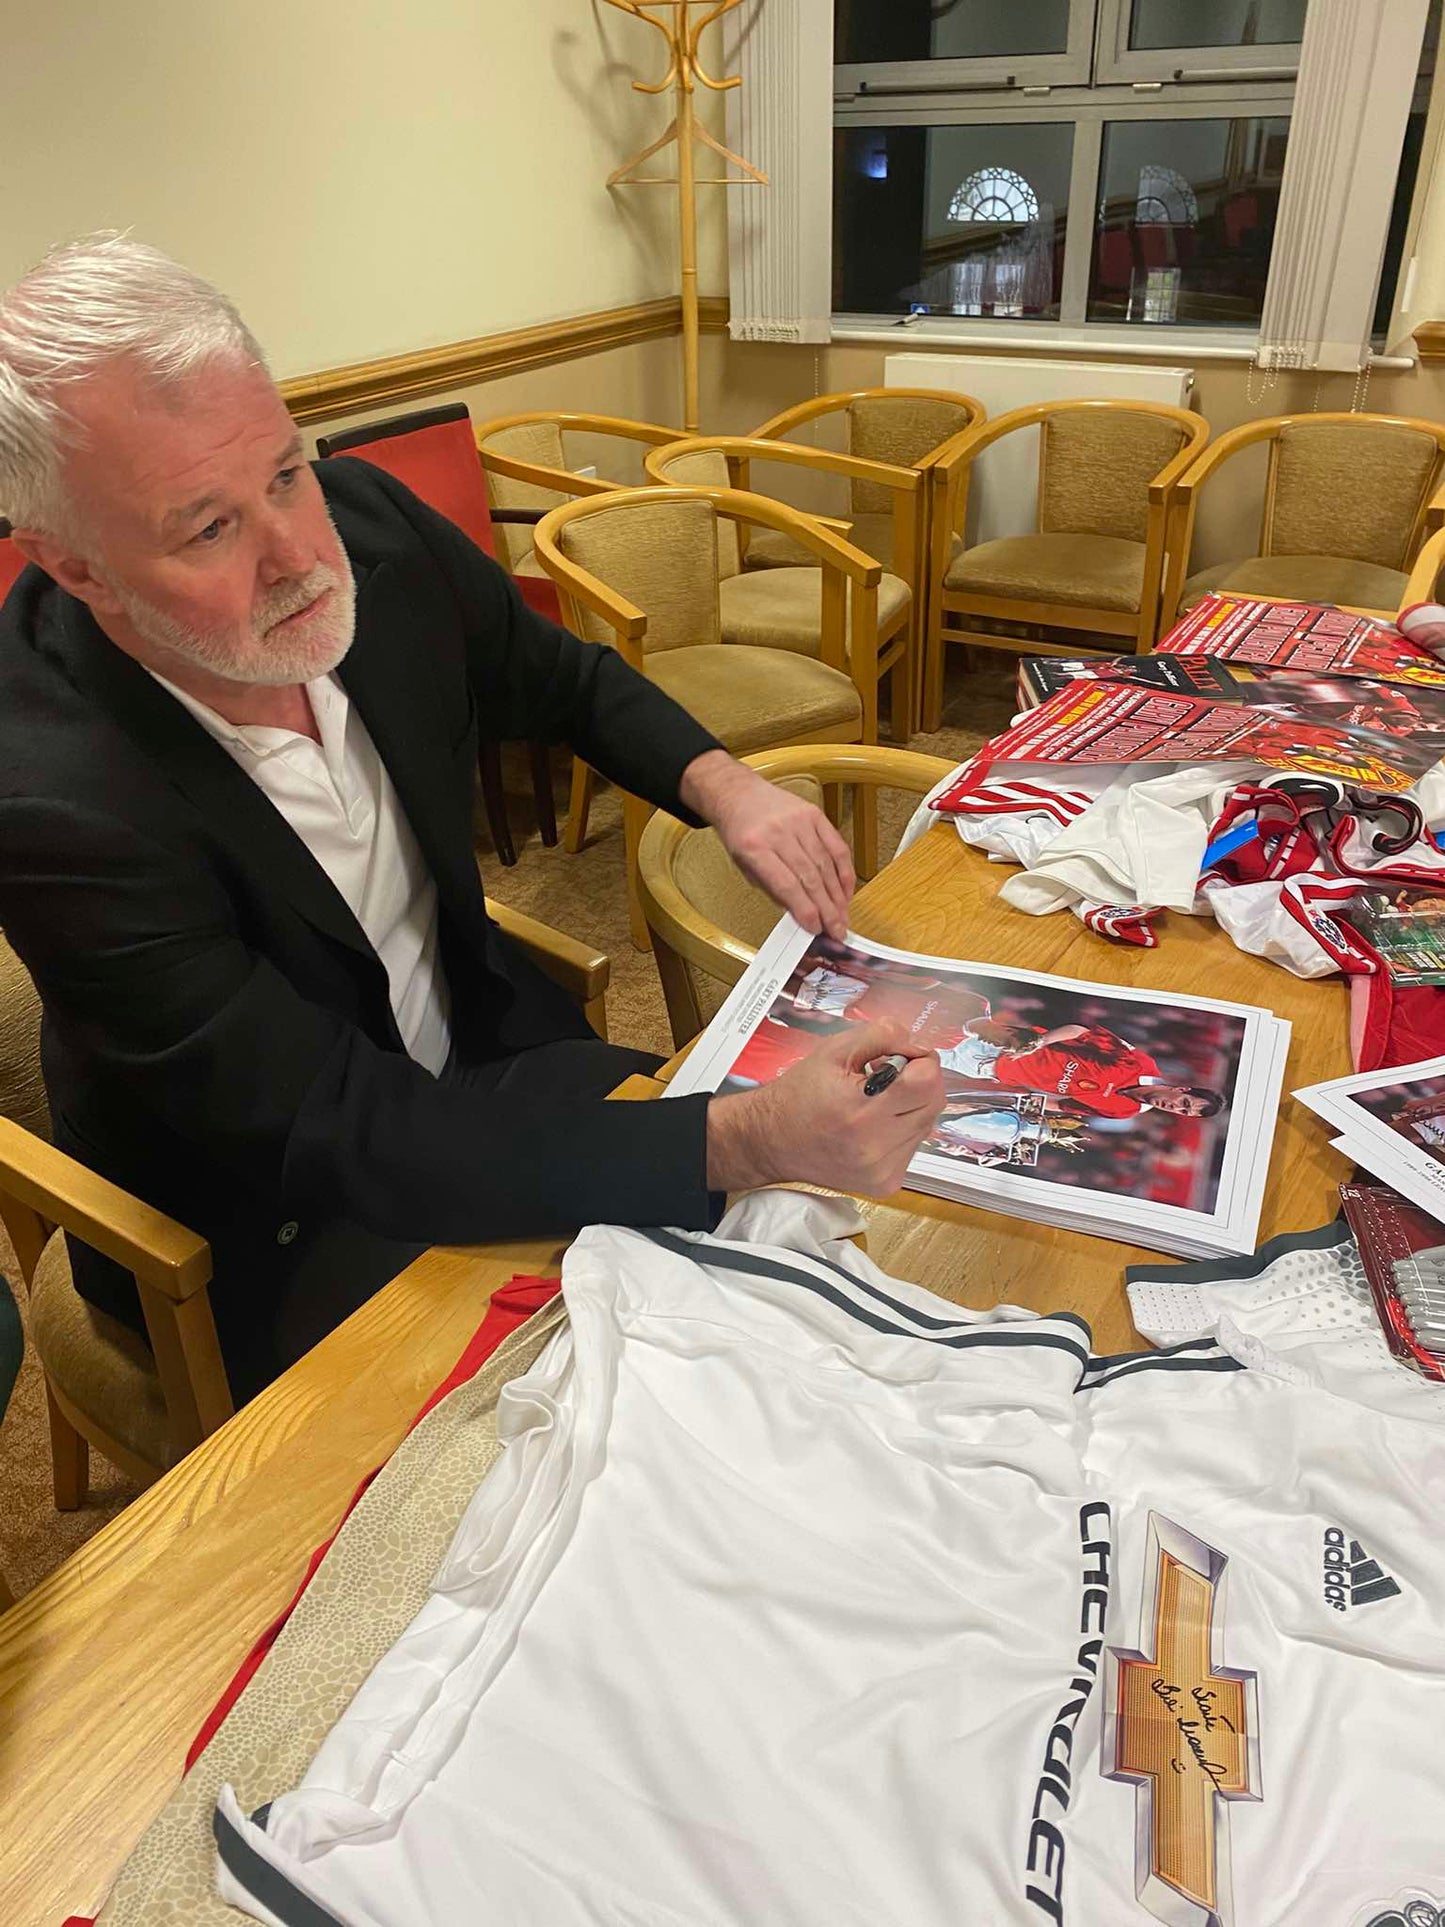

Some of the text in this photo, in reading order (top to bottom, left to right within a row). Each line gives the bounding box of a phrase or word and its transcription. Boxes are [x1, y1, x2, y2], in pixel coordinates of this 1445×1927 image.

[1175, 655, 1223, 692] PALLY
[1125, 696, 1198, 725] GARY
[1067, 721, 1169, 760] PALLISTER
[1057, 1061, 1079, 1095] SHARP
[1324, 1527, 1350, 1612] adidas
